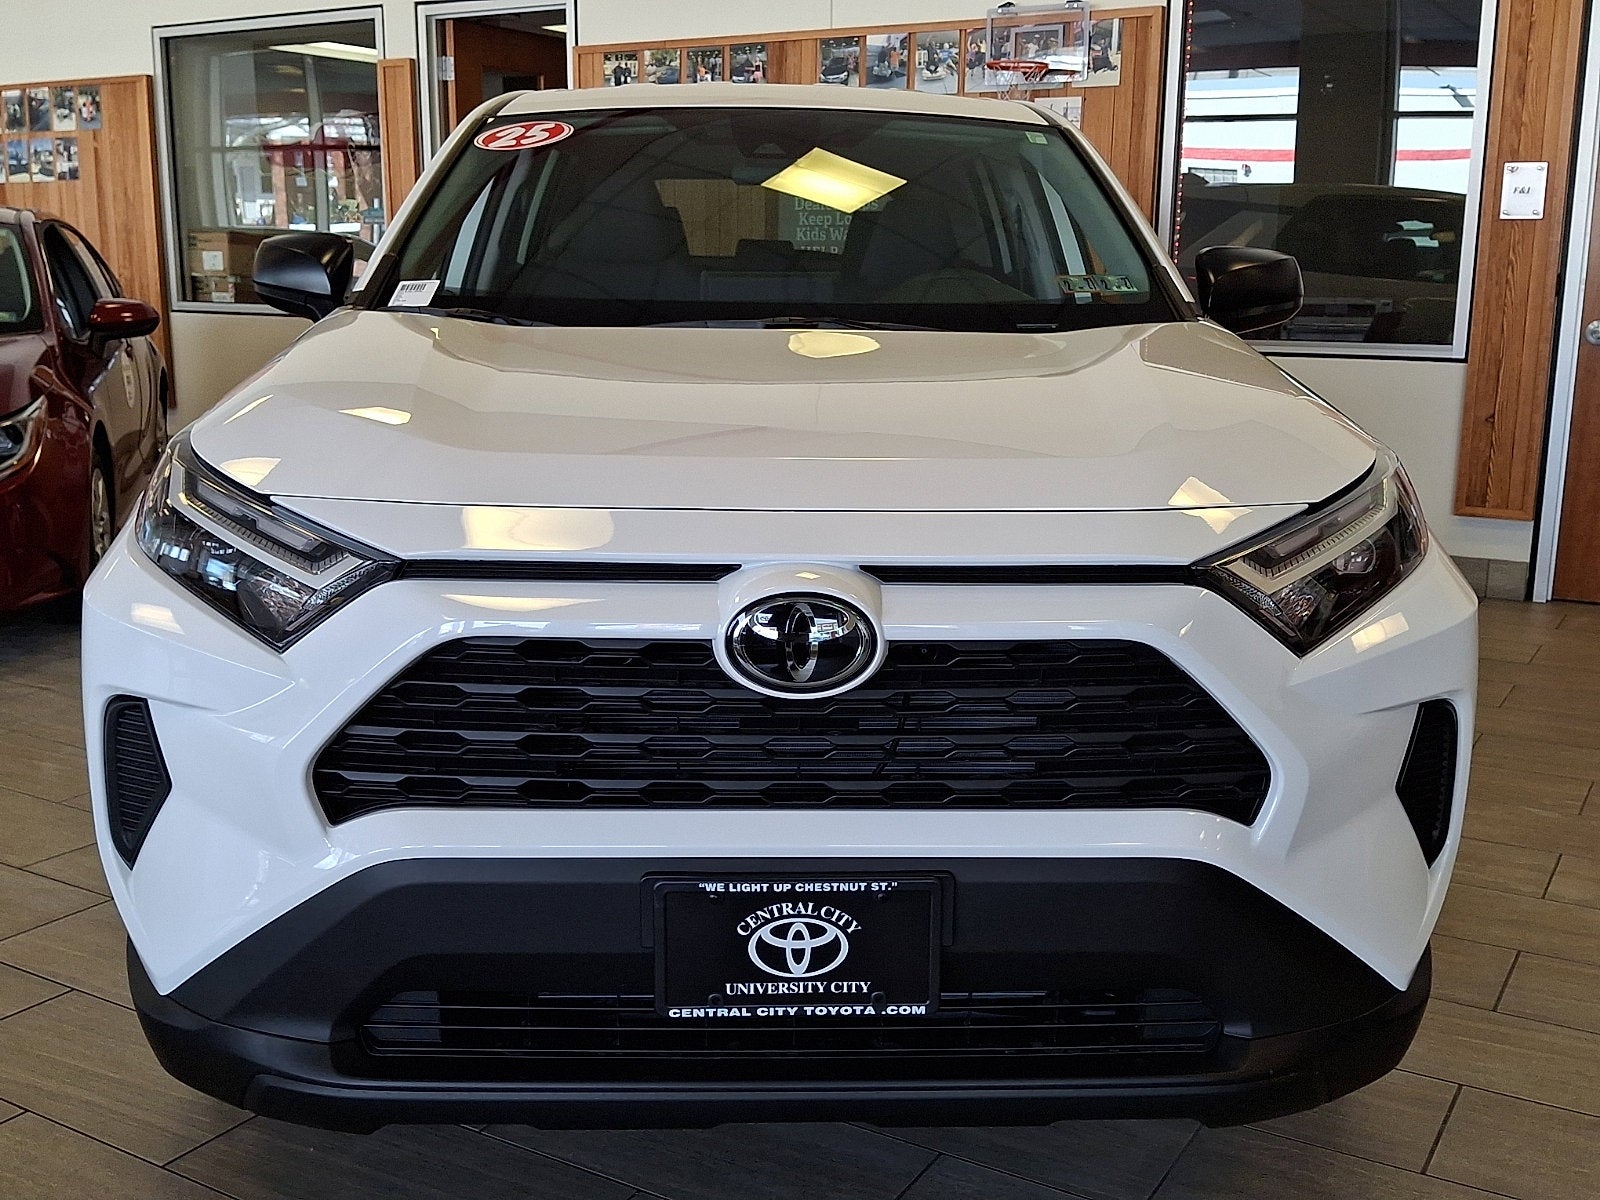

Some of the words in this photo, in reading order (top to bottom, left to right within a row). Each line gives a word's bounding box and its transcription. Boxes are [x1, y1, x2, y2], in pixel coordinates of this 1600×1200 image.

[487, 123, 556, 148] 25
[799, 212, 832, 228] Keep
[796, 227, 826, 241] Kids
[729, 882, 769, 892] LIGHT
[773, 882, 792, 892] UP
[795, 882, 868, 892] CHESTNUT
[736, 901, 818, 936] CENTRAL
[820, 905, 862, 934] CITY
[726, 982, 827, 995] UNIVERSITY
[831, 981, 871, 994] CITY
[669, 1006, 751, 1018] CENTRAL
[756, 1006, 798, 1016] CITY
[804, 1006, 876, 1016] TOYOTA
[881, 1005, 926, 1015] .COM
